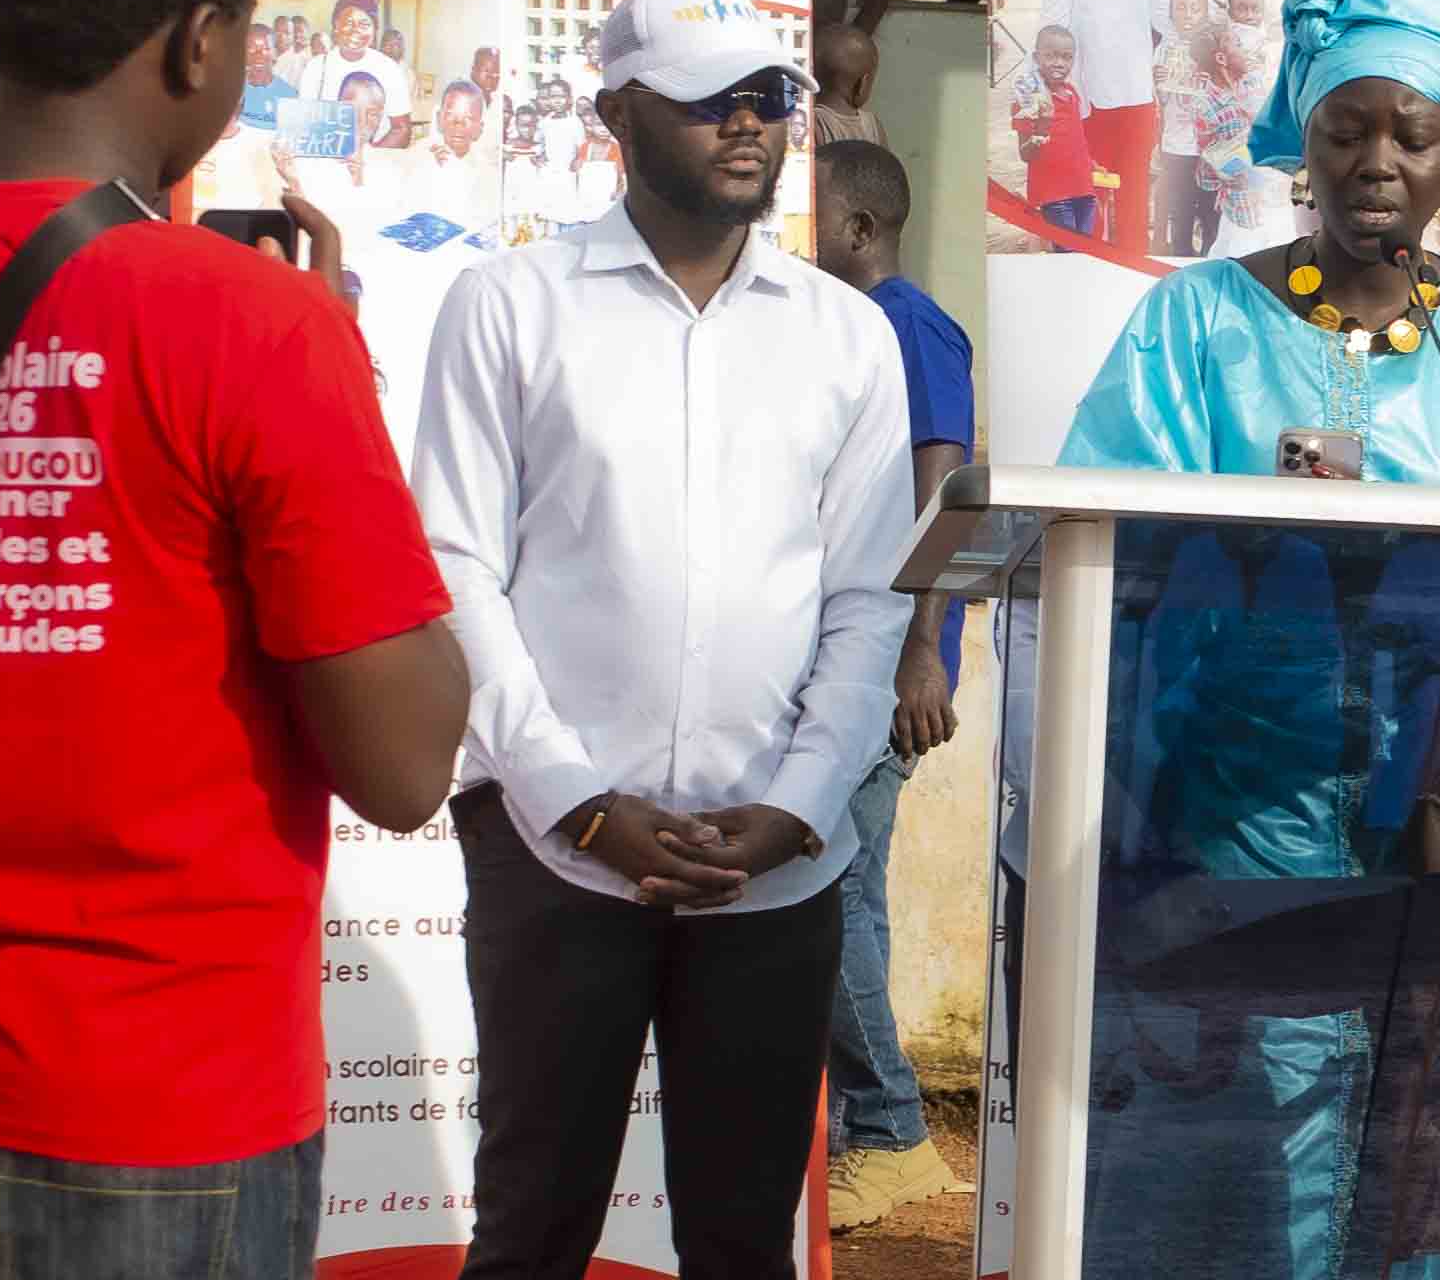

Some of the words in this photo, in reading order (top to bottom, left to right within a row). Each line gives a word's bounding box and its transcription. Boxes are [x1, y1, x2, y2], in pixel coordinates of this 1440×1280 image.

[57, 531, 112, 566] et
[324, 917, 401, 937] ance
[339, 1053, 449, 1078] scolaire
[329, 1099, 400, 1124] fants
[410, 1098, 447, 1121] de
[326, 1194, 369, 1216] ire
[381, 1191, 431, 1212] des
